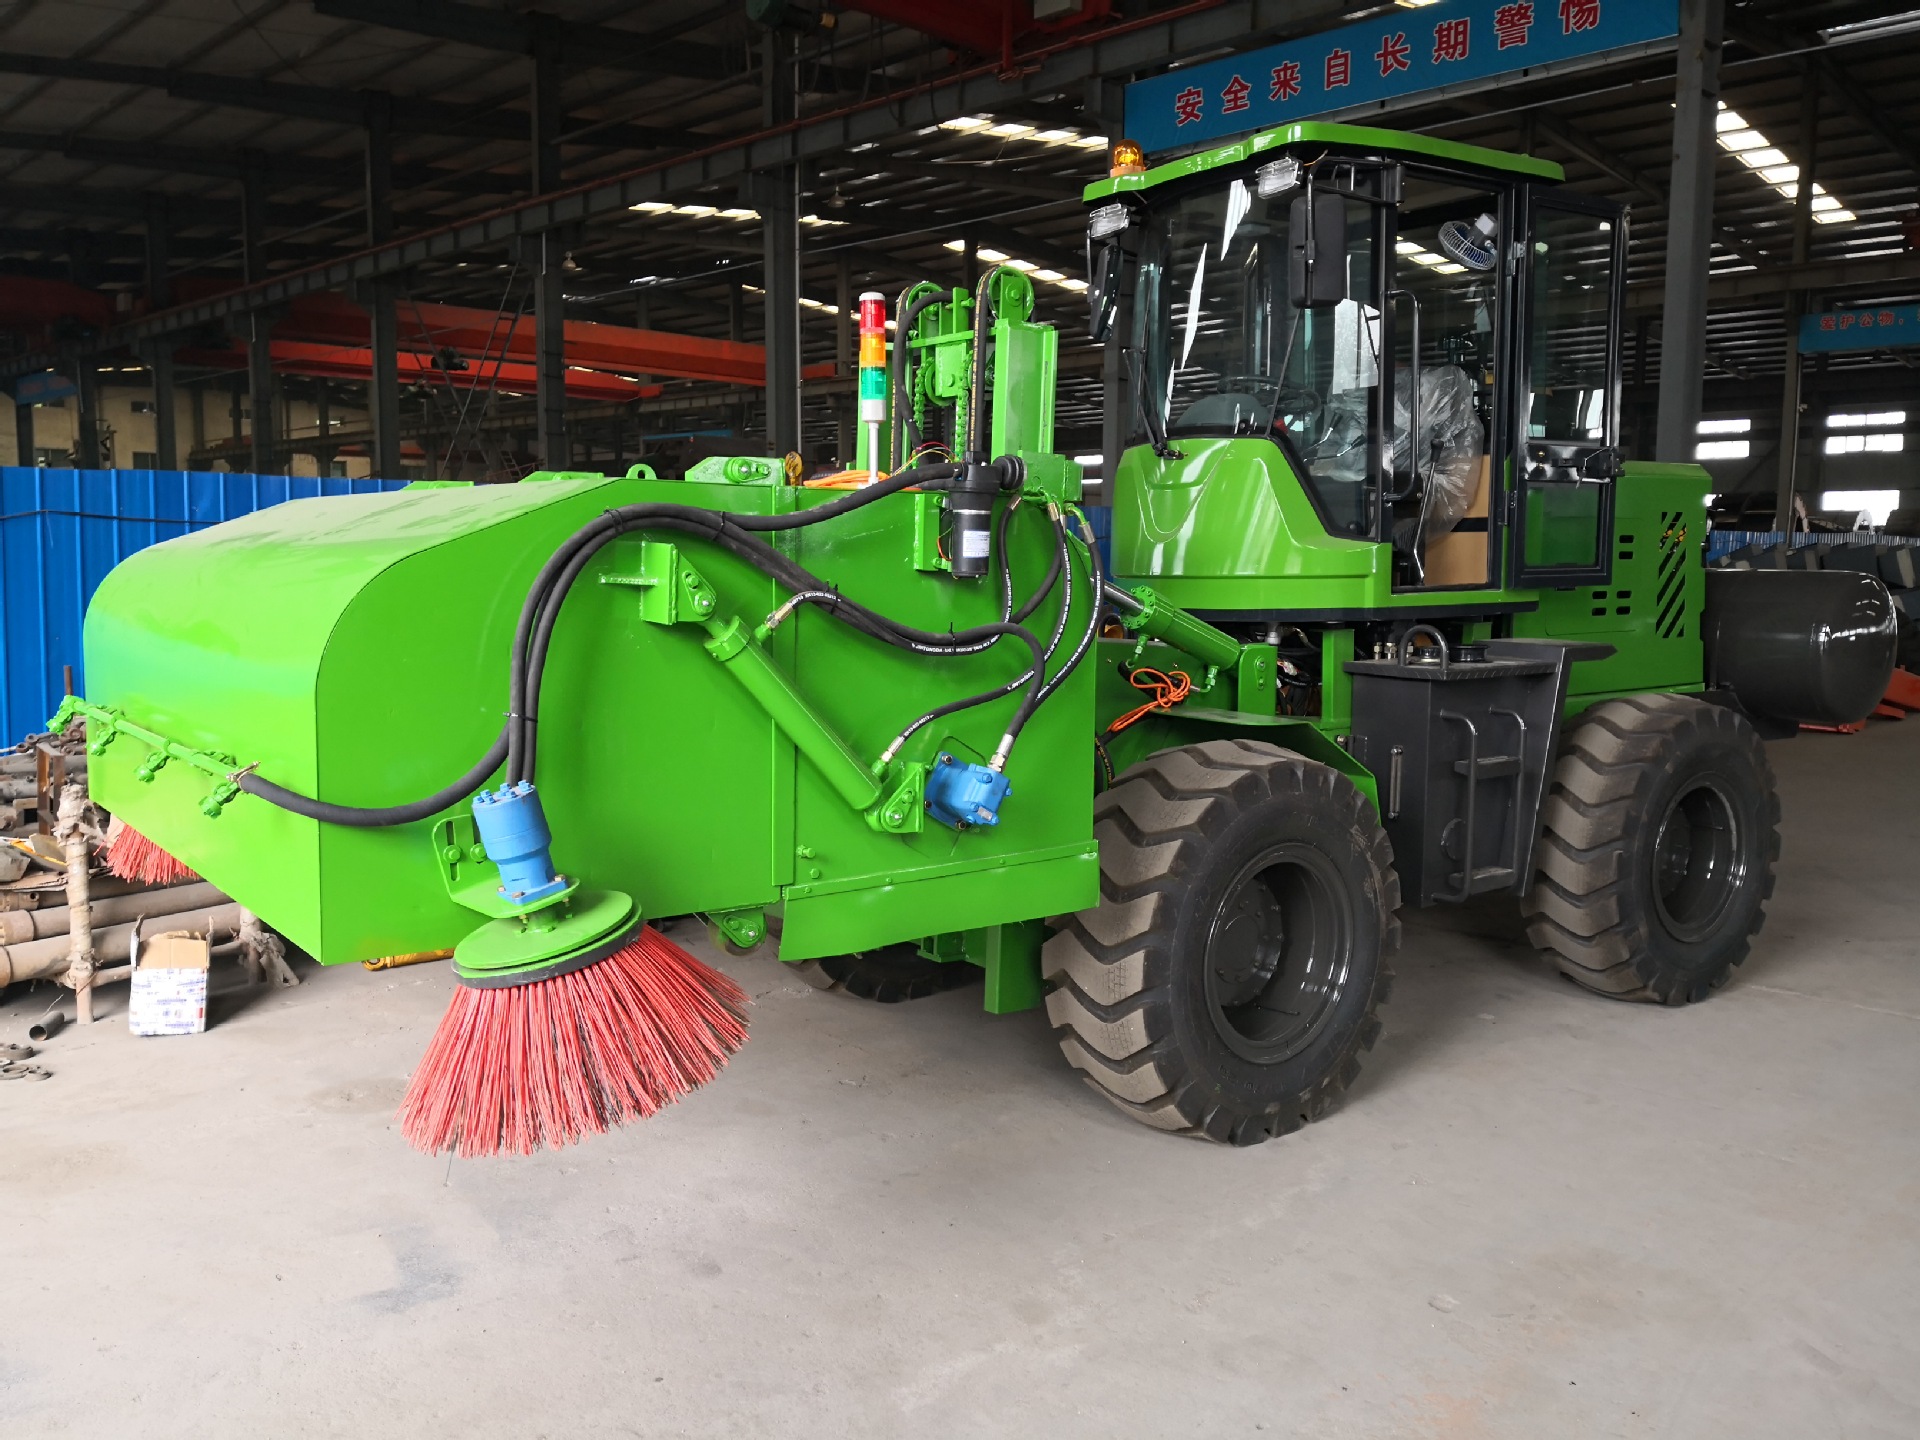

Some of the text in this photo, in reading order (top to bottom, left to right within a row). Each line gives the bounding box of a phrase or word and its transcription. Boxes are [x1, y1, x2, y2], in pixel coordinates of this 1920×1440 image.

[1175, 0, 1600, 127] 安全来自长期警惕
